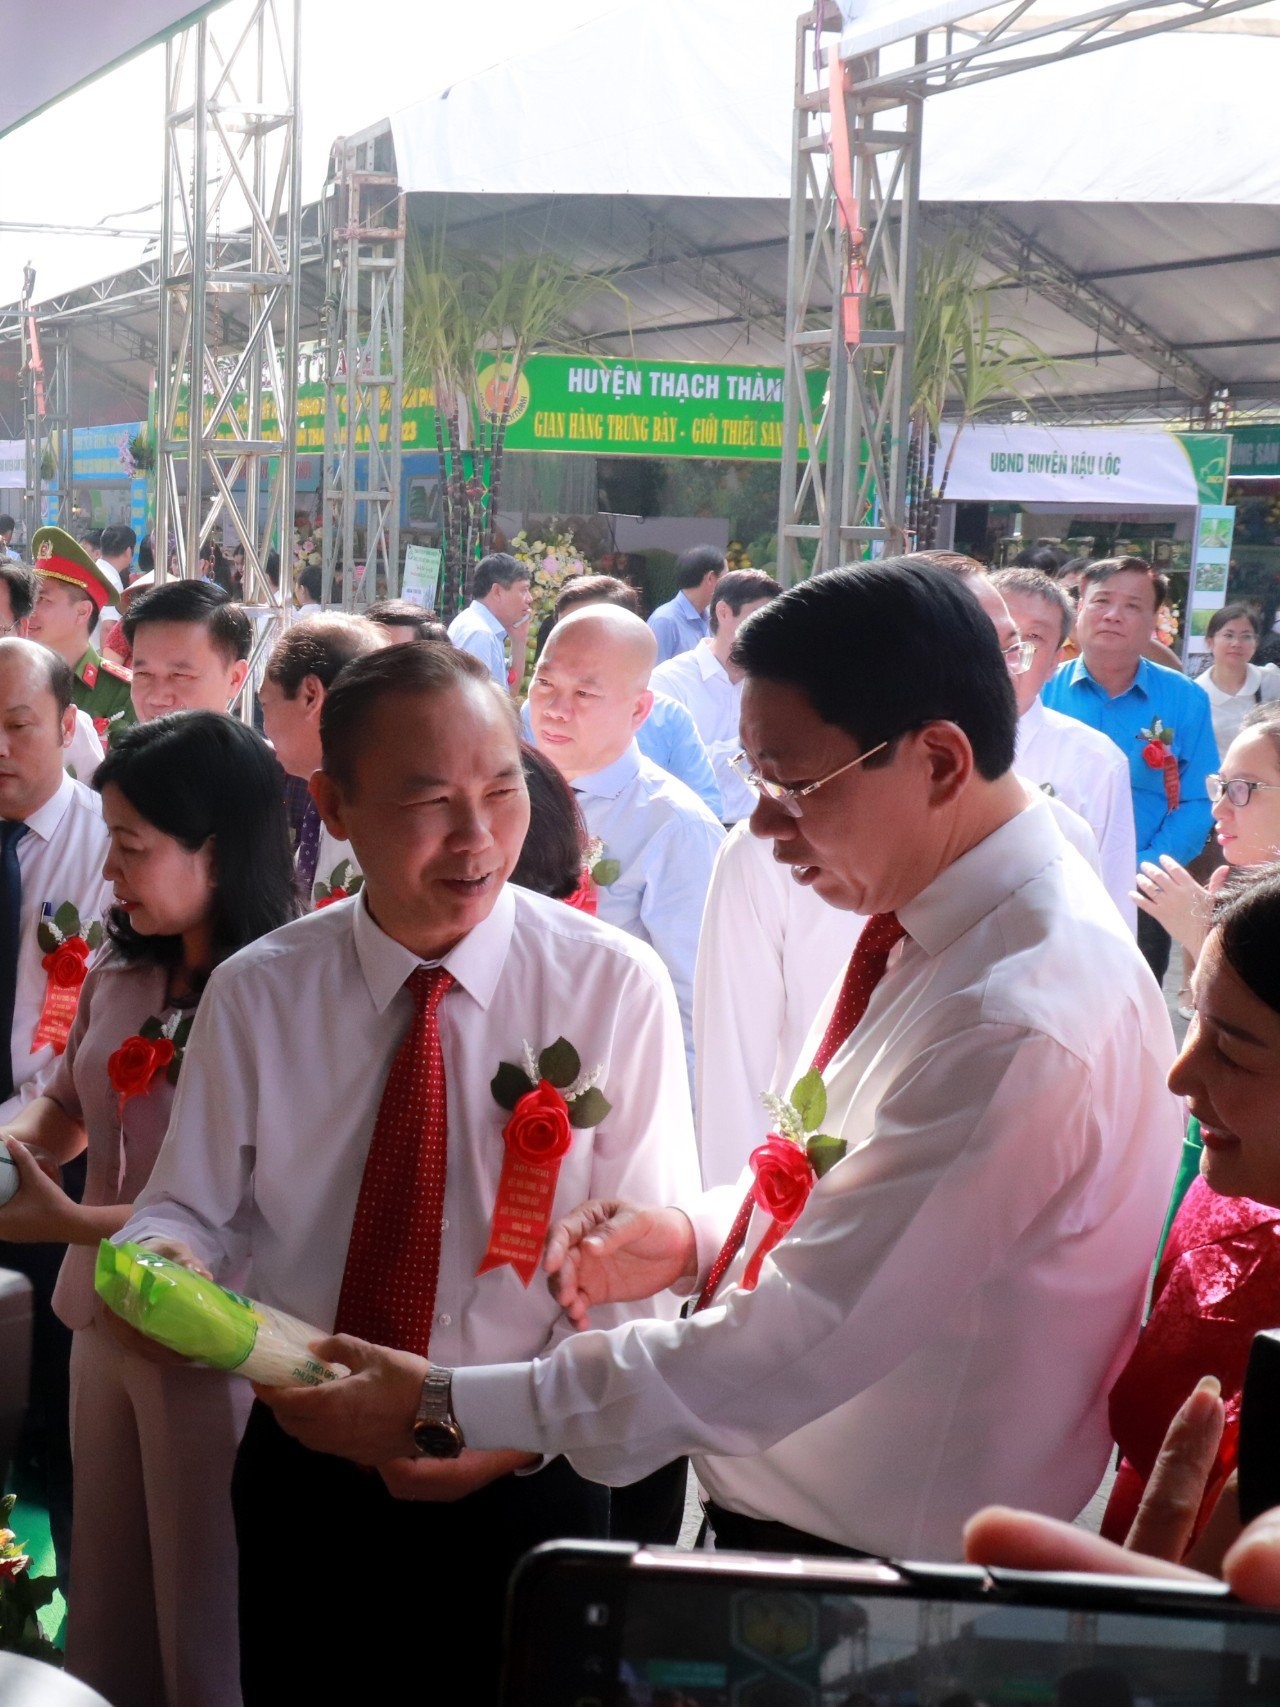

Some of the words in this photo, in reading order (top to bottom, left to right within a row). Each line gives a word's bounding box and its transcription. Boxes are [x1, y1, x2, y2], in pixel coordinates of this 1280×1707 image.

[568, 365, 642, 400] HUYỆN
[649, 371, 719, 403] THẠCH
[727, 372, 784, 402] THÀN
[534, 412, 565, 439] GIAN
[568, 407, 604, 440] HÀNG
[652, 411, 678, 443] BÀY
[990, 453, 1024, 473] UBND
[1028, 450, 1067, 478] HUYỆN
[1071, 451, 1095, 479] HẬU
[1099, 451, 1121, 480] LỘC
